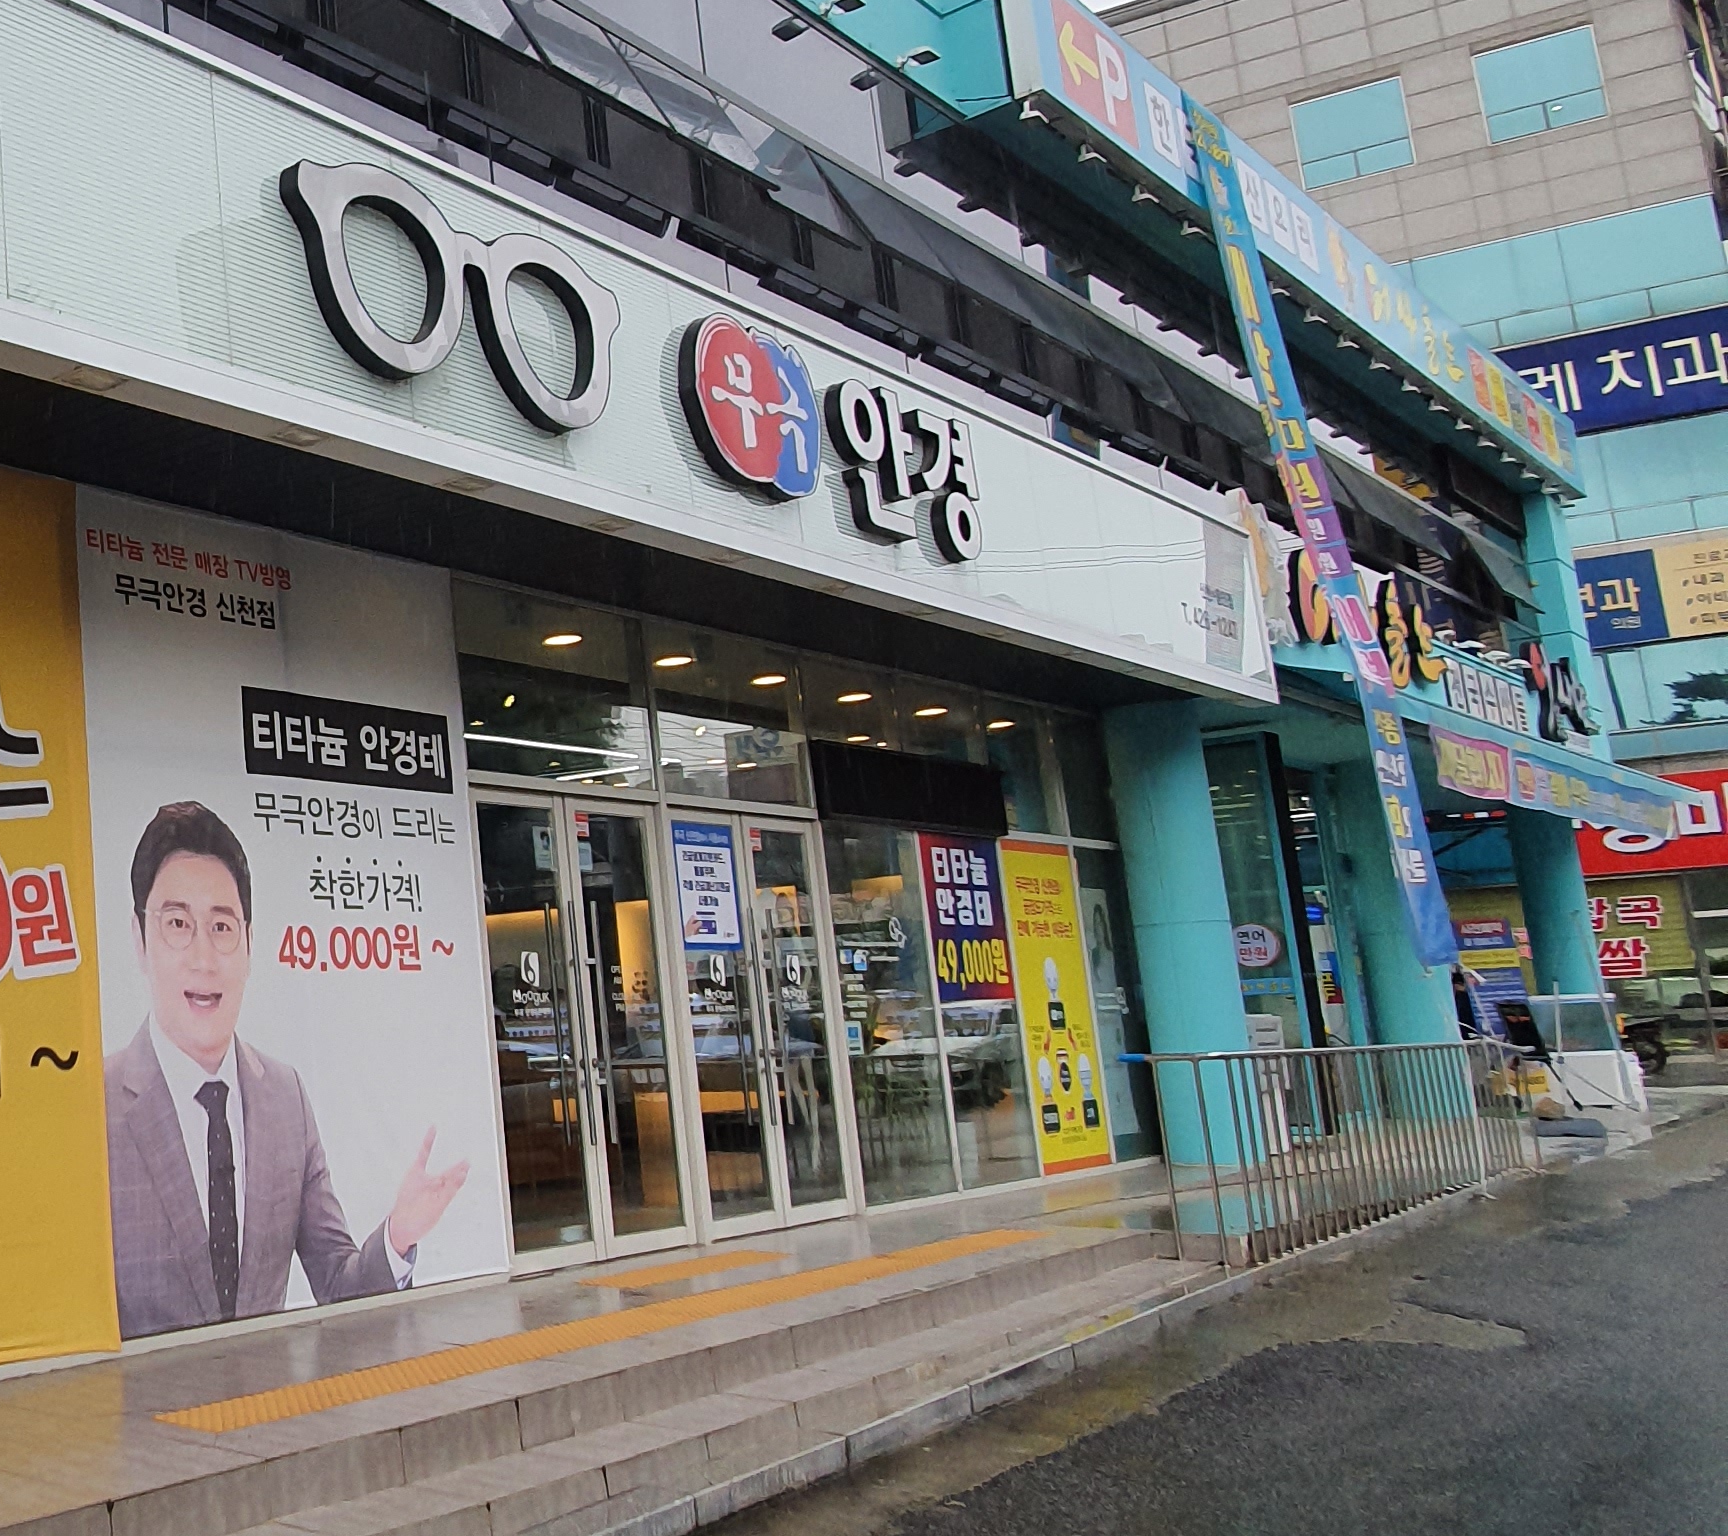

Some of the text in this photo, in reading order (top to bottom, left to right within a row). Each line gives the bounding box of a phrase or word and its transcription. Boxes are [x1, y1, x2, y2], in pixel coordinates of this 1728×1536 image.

[1095, 31, 1130, 128] P
[1595, 332, 1728, 397] 치과
[830, 378, 983, 564] 안경
[86, 528, 292, 591] 티타늄 전문 매장 TV방영
[114, 572, 277, 630] 무극안경 신천점
[251, 710, 446, 780] 티타늄 안경테
[253, 792, 456, 845] 무극안경이 드리는
[309, 866, 423, 914] 착한가격!
[930, 846, 989, 887] 티타늄
[937, 938, 1010, 991] 49,000원
[1597, 935, 1651, 980] 쌀
